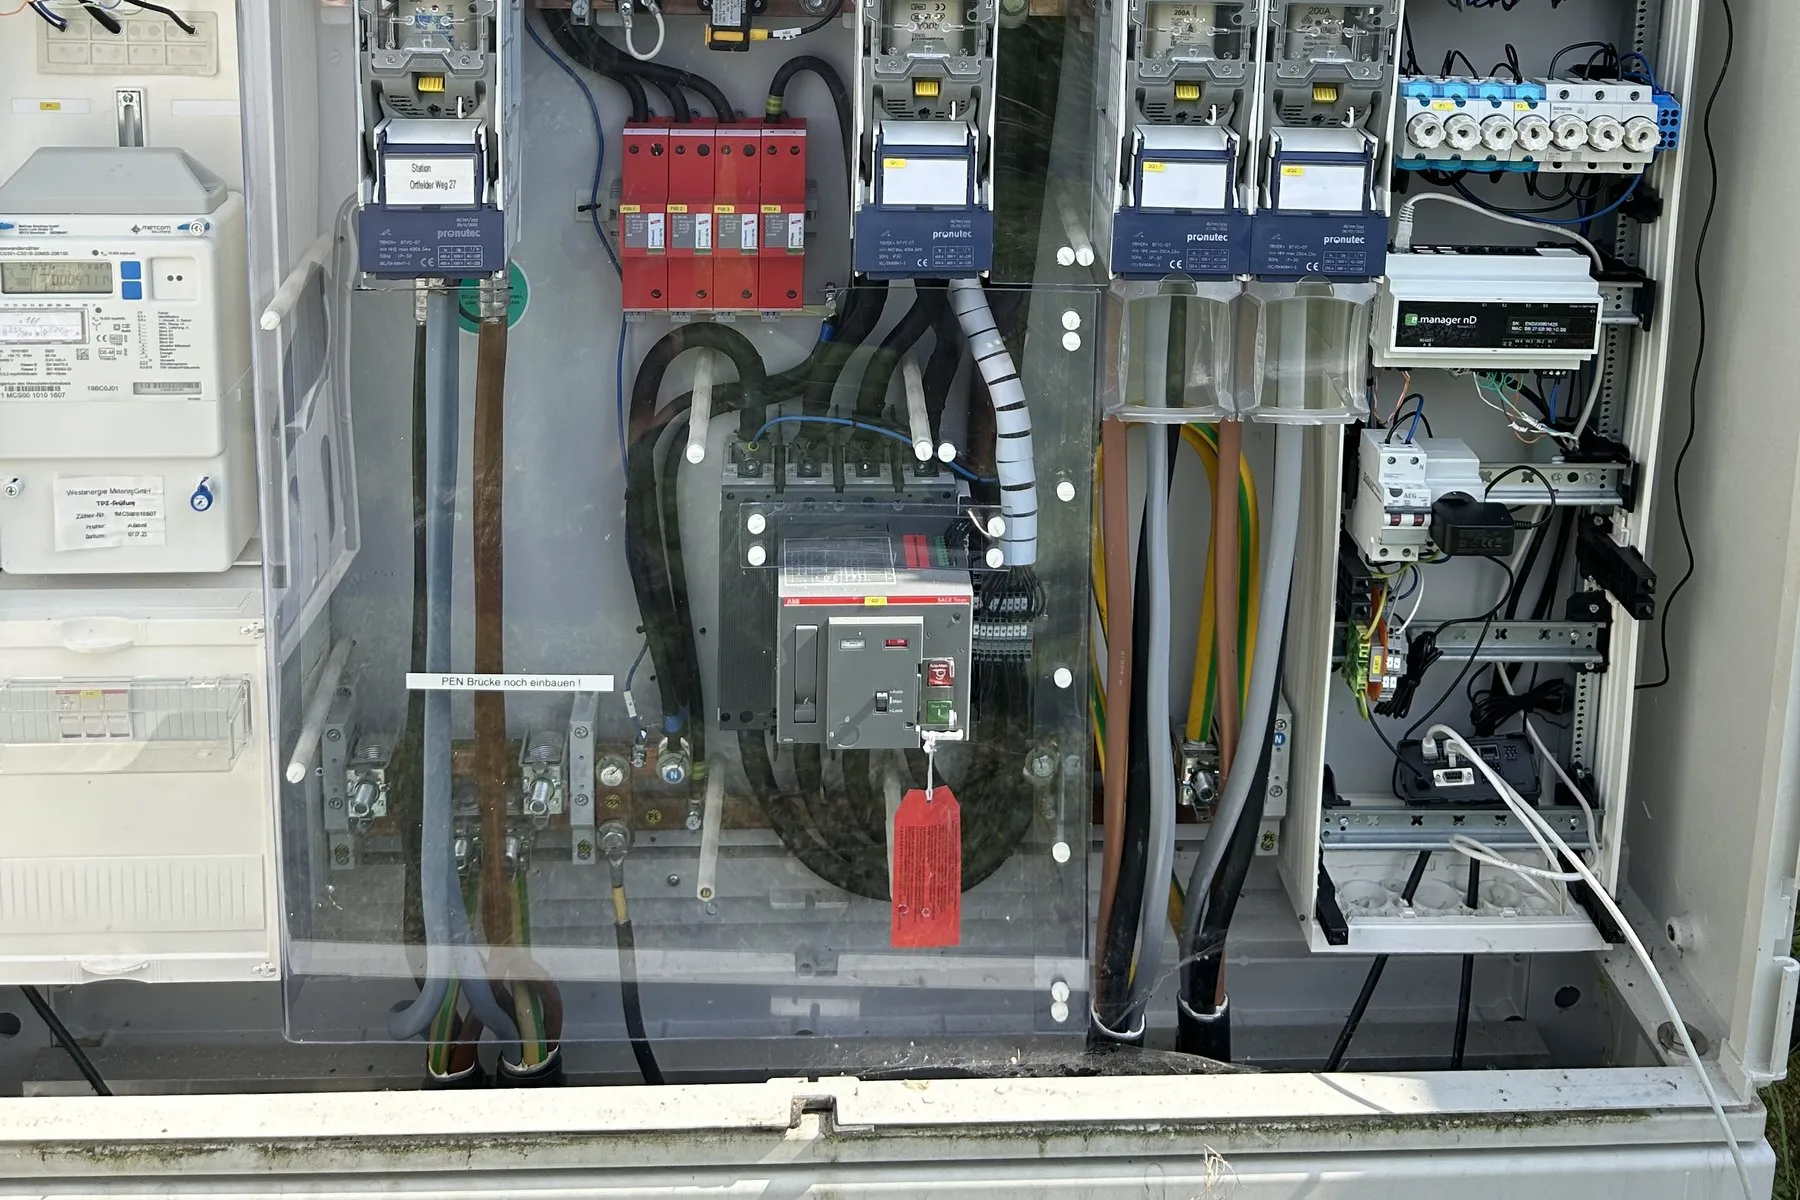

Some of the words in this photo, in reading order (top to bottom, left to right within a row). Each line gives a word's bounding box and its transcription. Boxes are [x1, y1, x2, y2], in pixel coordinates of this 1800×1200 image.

[1308, 6, 1332, 15] 200A
[411, 162, 432, 173] Station
[435, 180, 448, 191] Weg
[449, 179, 457, 190] 27
[437, 229, 481, 240] pronutec
[932, 230, 973, 240] pronutec
[1187, 233, 1228, 243] pronutec
[1323, 234, 1365, 245] pronutec
[1463, 315, 1478, 325] nD
[441, 676, 464, 687] PEN
[467, 677, 501, 688] Brücke
[503, 678, 527, 688] noch
[530, 679, 576, 688] einbauen
[670, 770, 678, 780] N
